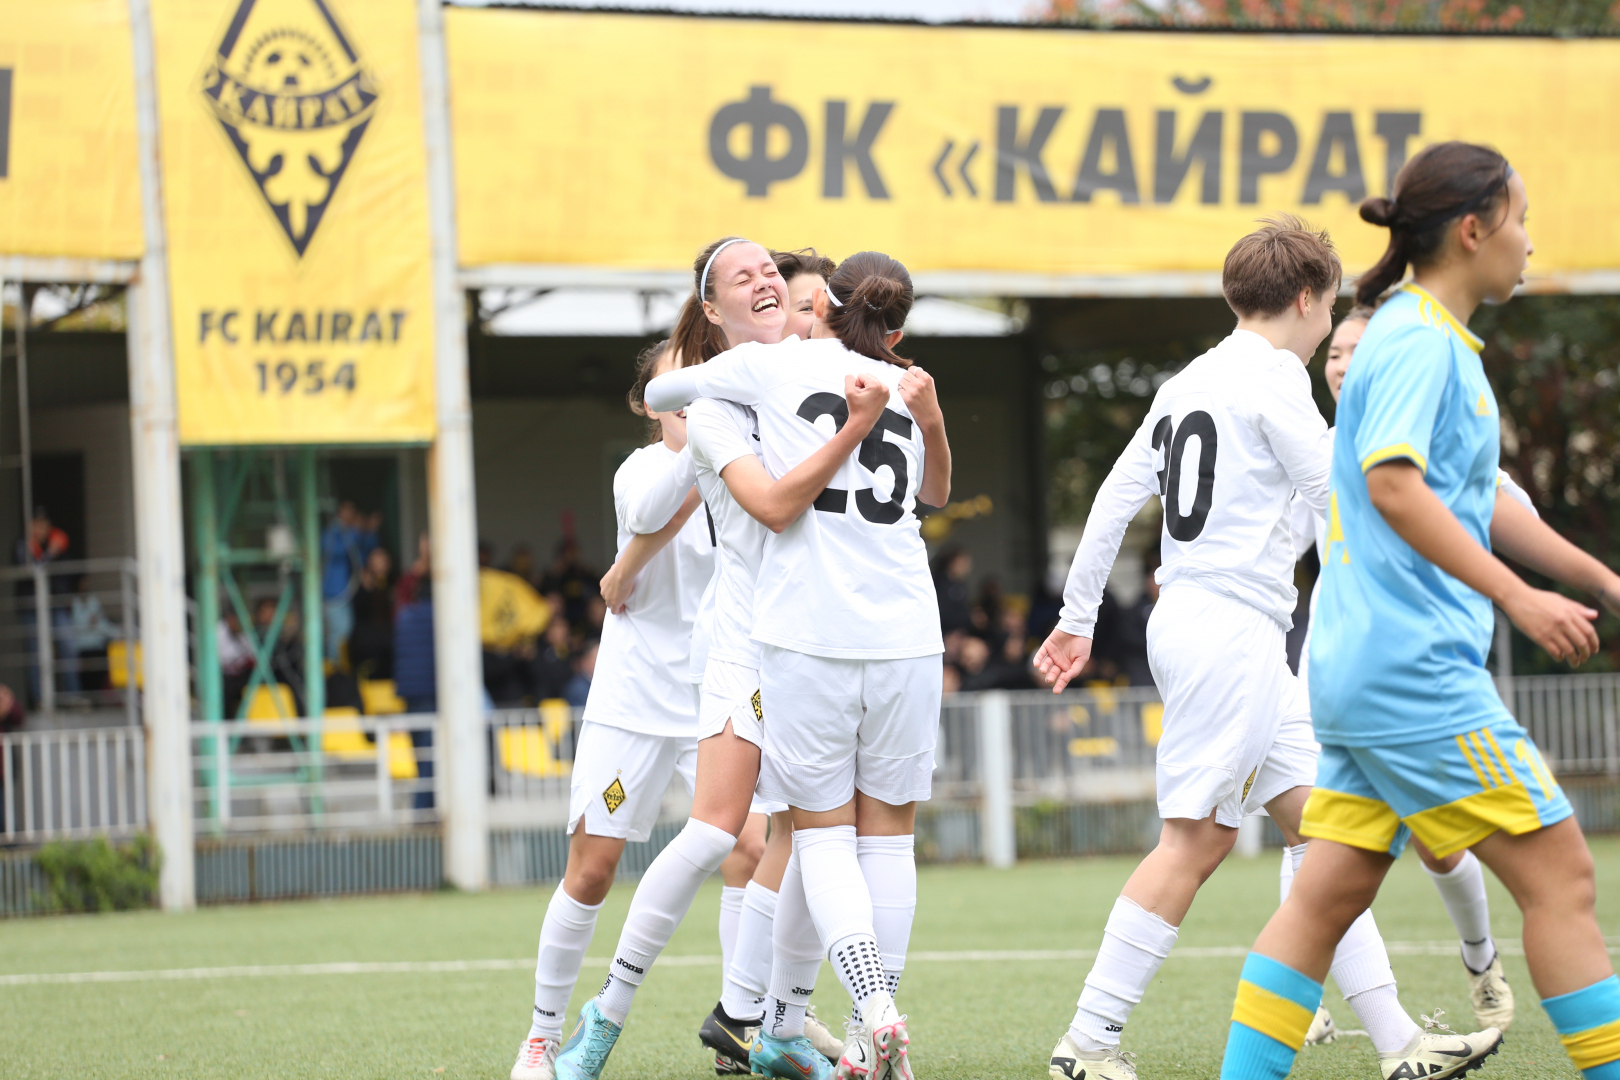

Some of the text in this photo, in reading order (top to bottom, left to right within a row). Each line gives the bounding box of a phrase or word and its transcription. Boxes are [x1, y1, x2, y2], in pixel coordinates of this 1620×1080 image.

[708, 85, 897, 200] ФК
[198, 308, 409, 345] FC KAIRAT
[255, 360, 358, 395] 1954
[796, 391, 913, 525] 25
[616, 957, 644, 975] Joma
[791, 986, 814, 996] Jom
